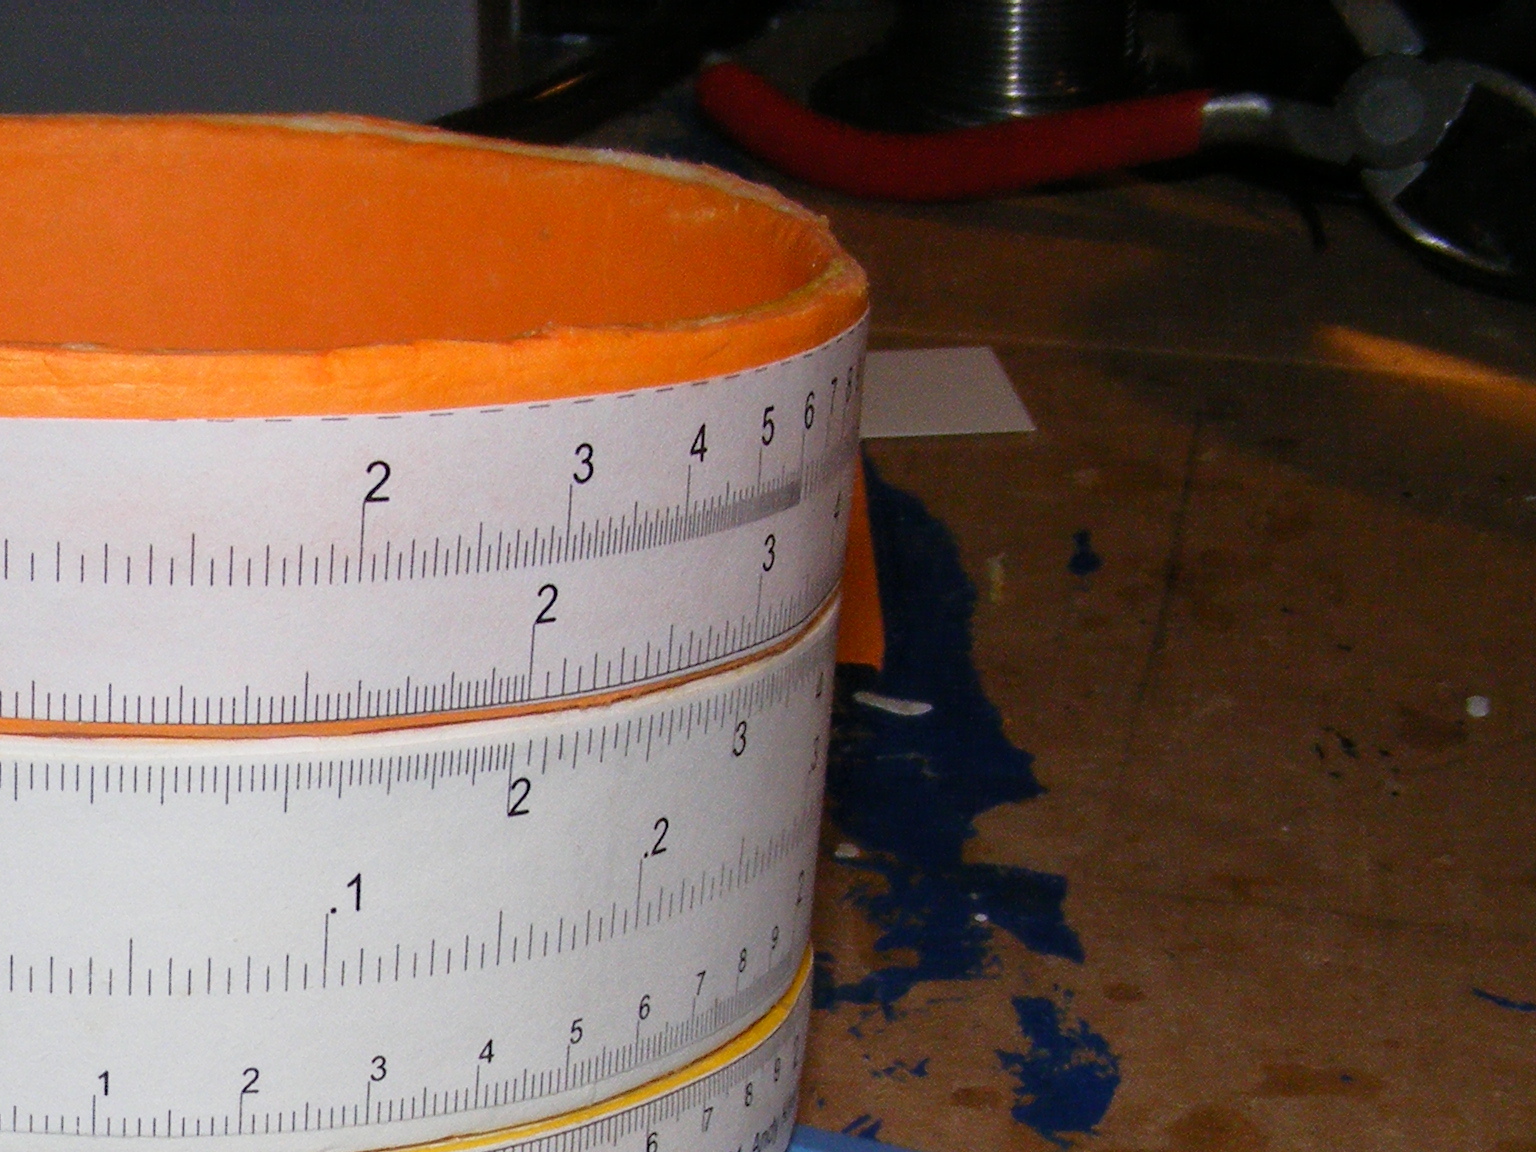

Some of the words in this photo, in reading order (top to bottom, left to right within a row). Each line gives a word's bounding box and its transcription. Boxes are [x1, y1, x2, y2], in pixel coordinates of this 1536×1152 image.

[364, 460, 392, 502] 2
[573, 443, 595, 484] 3
[689, 423, 708, 462] 4
[761, 404, 775, 446] 5
[803, 390, 816, 430] 6
[534, 583, 560, 625] 2
[762, 534, 777, 572] 3
[507, 777, 532, 817] 2
[732, 720, 748, 757] 3
[329, 872, 365, 915] .1
[643, 817, 669, 859] .2
[97, 1070, 111, 1097] 1
[241, 1067, 261, 1095] 2
[370, 1055, 388, 1082] 3
[478, 1039, 495, 1064] 4
[569, 1019, 584, 1045] 5
[637, 995, 652, 1020] 6
[696, 969, 707, 996] 7
[738, 946, 748, 973] 8
[771, 924, 780, 951] 9
[701, 1106, 714, 1132] 7
[744, 1081, 754, 1107] 8
